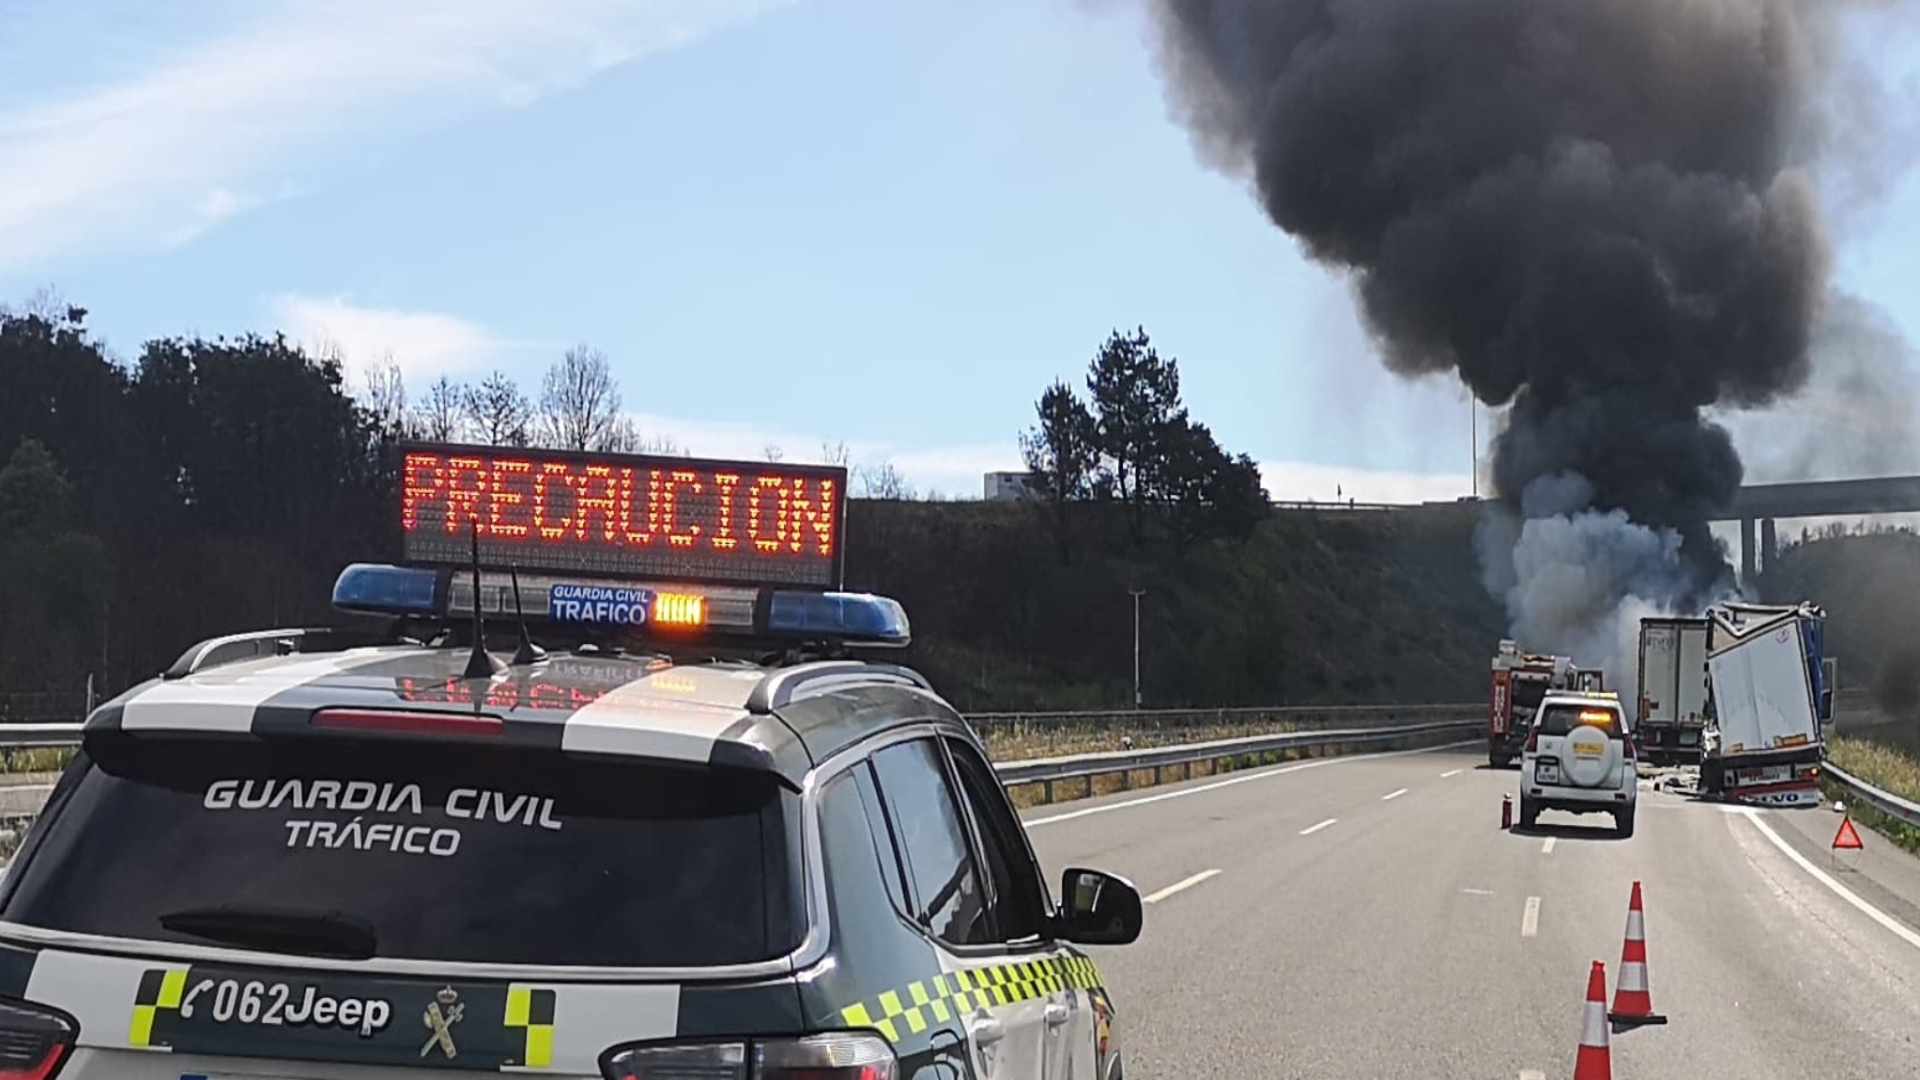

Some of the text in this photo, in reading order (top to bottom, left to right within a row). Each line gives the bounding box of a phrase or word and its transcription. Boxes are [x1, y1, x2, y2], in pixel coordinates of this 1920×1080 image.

[402, 453, 833, 554] PRECAUCION
[552, 600, 646, 625] TRAFICO
[554, 586, 649, 603] GUARDIA CIVIL
[204, 780, 563, 829] GUARDIA CIVIL
[285, 818, 460, 855] TRÁFICO
[214, 979, 390, 1035] 062 Jeep
